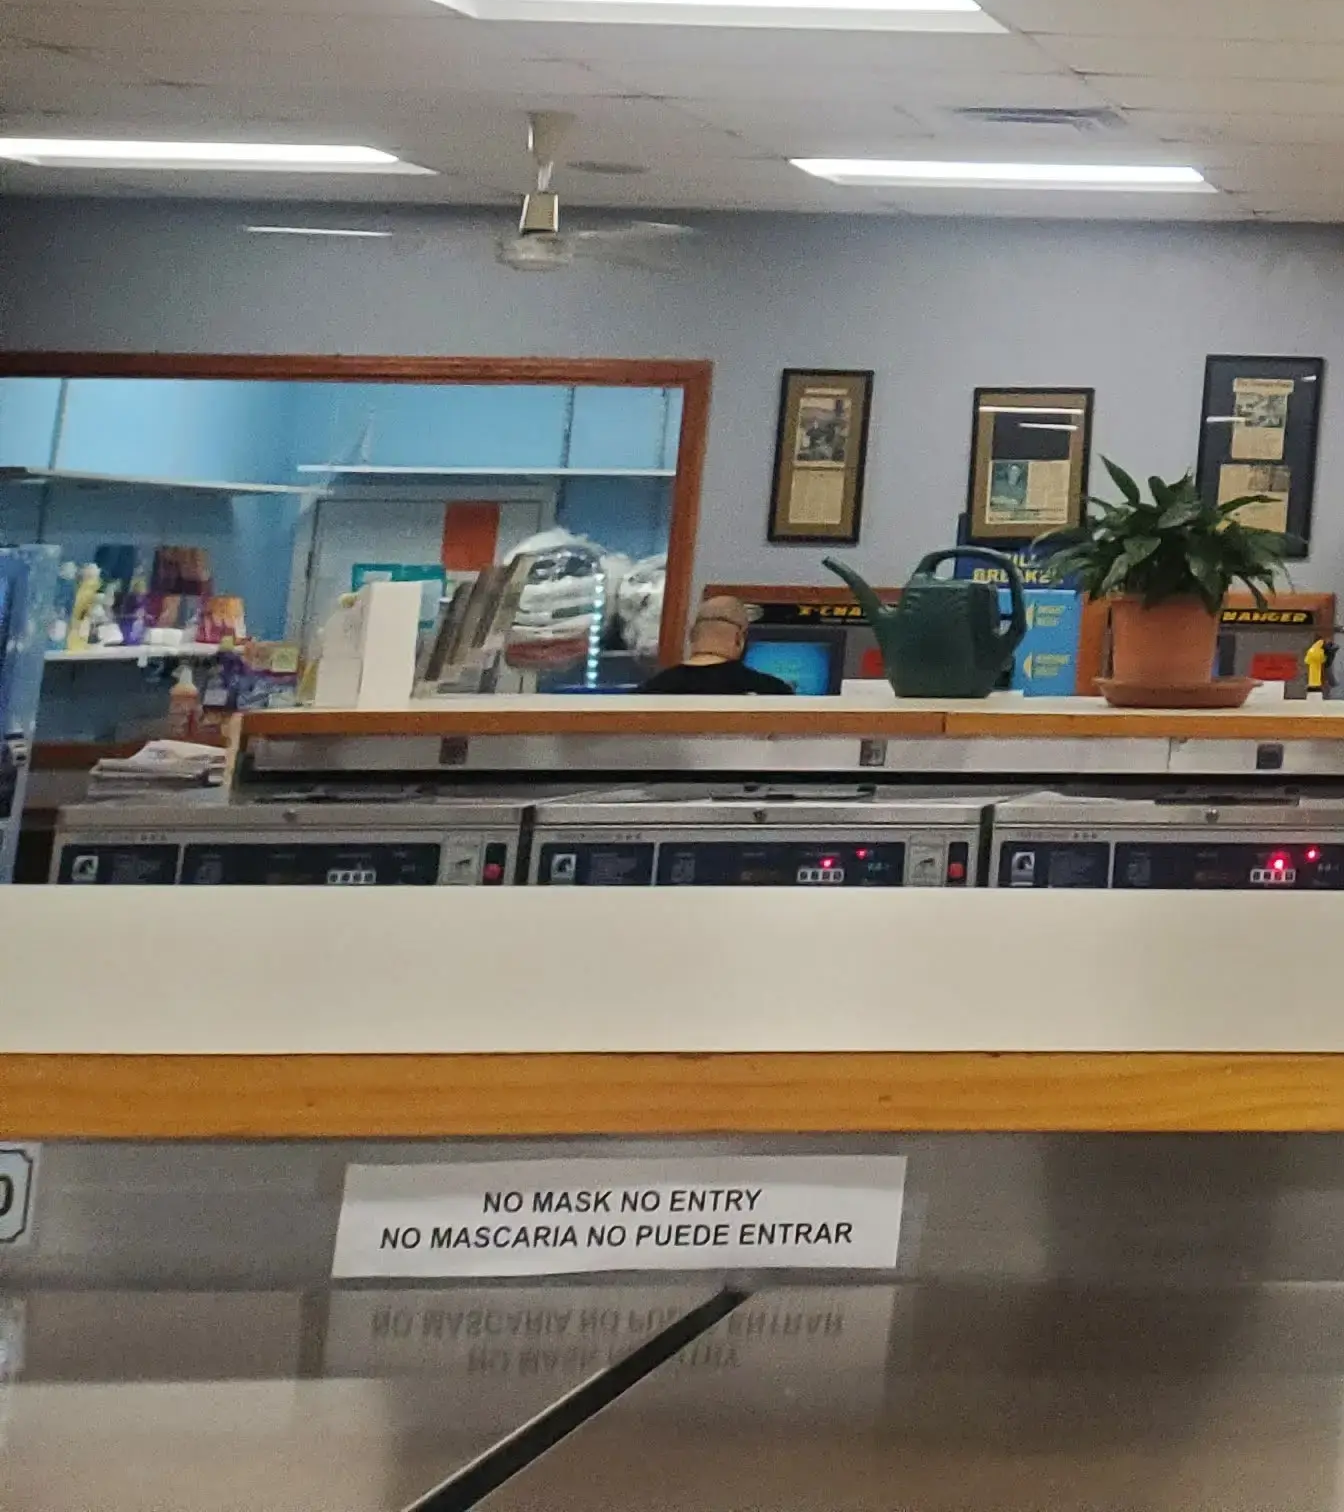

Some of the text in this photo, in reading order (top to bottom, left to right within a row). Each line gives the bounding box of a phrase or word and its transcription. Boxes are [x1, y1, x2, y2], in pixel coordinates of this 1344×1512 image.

[482, 1188, 763, 1214] NO MASK NO ENTRY
[380, 1222, 854, 1250] NO MASCARIA NO PUEDE ENTRAR
